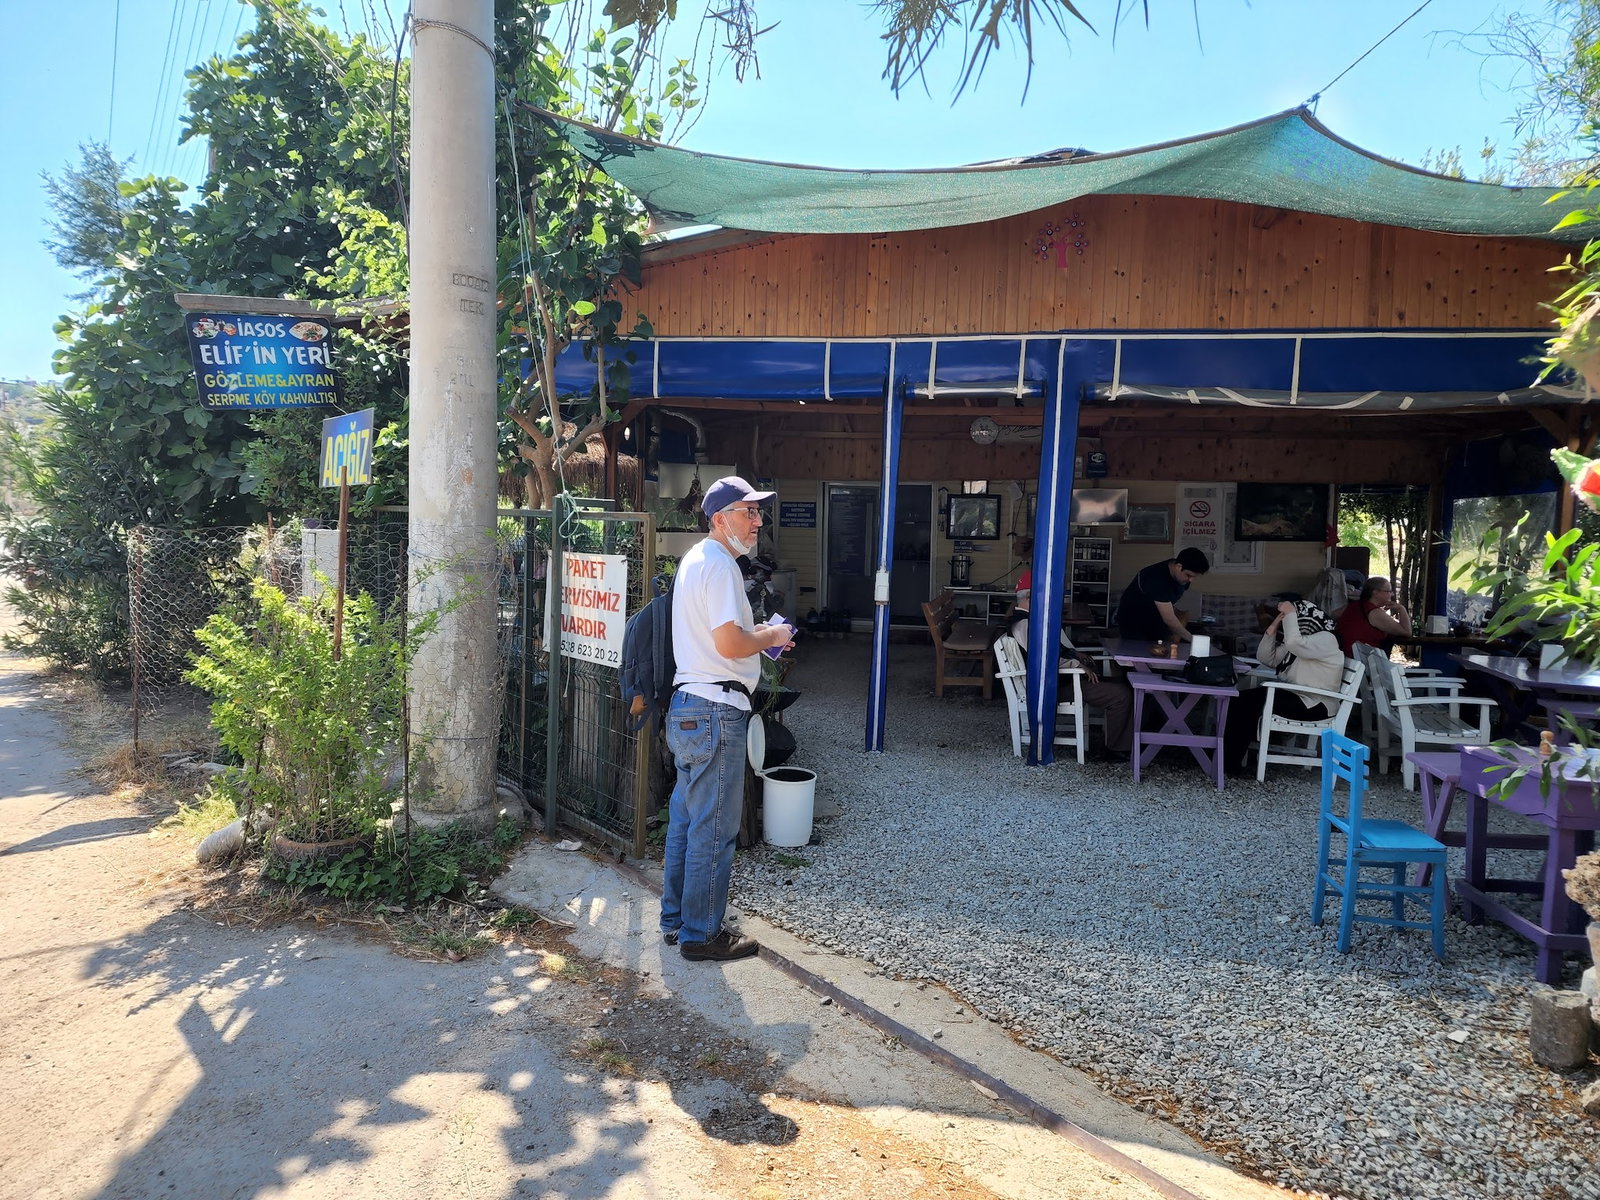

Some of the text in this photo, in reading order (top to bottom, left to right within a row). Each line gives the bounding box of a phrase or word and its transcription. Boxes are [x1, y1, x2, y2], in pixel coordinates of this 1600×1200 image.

[237, 318, 286, 338] İASOS
[200, 340, 331, 365] ELİF'İN YERİ
[204, 370, 335, 389] GÖZLEME&AYRAN
[207, 390, 337, 406] SERPME KÖY KAHVALTISI
[1182, 528, 1217, 536] İÇİLMEZ
[1183, 520, 1216, 528] SİGARA
[565, 558, 606, 580] PAKET
[560, 584, 621, 612] ERVİSİMİZ
[578, 643, 592, 657] 623
[595, 647, 605, 660] 20
[607, 650, 618, 663] 22
